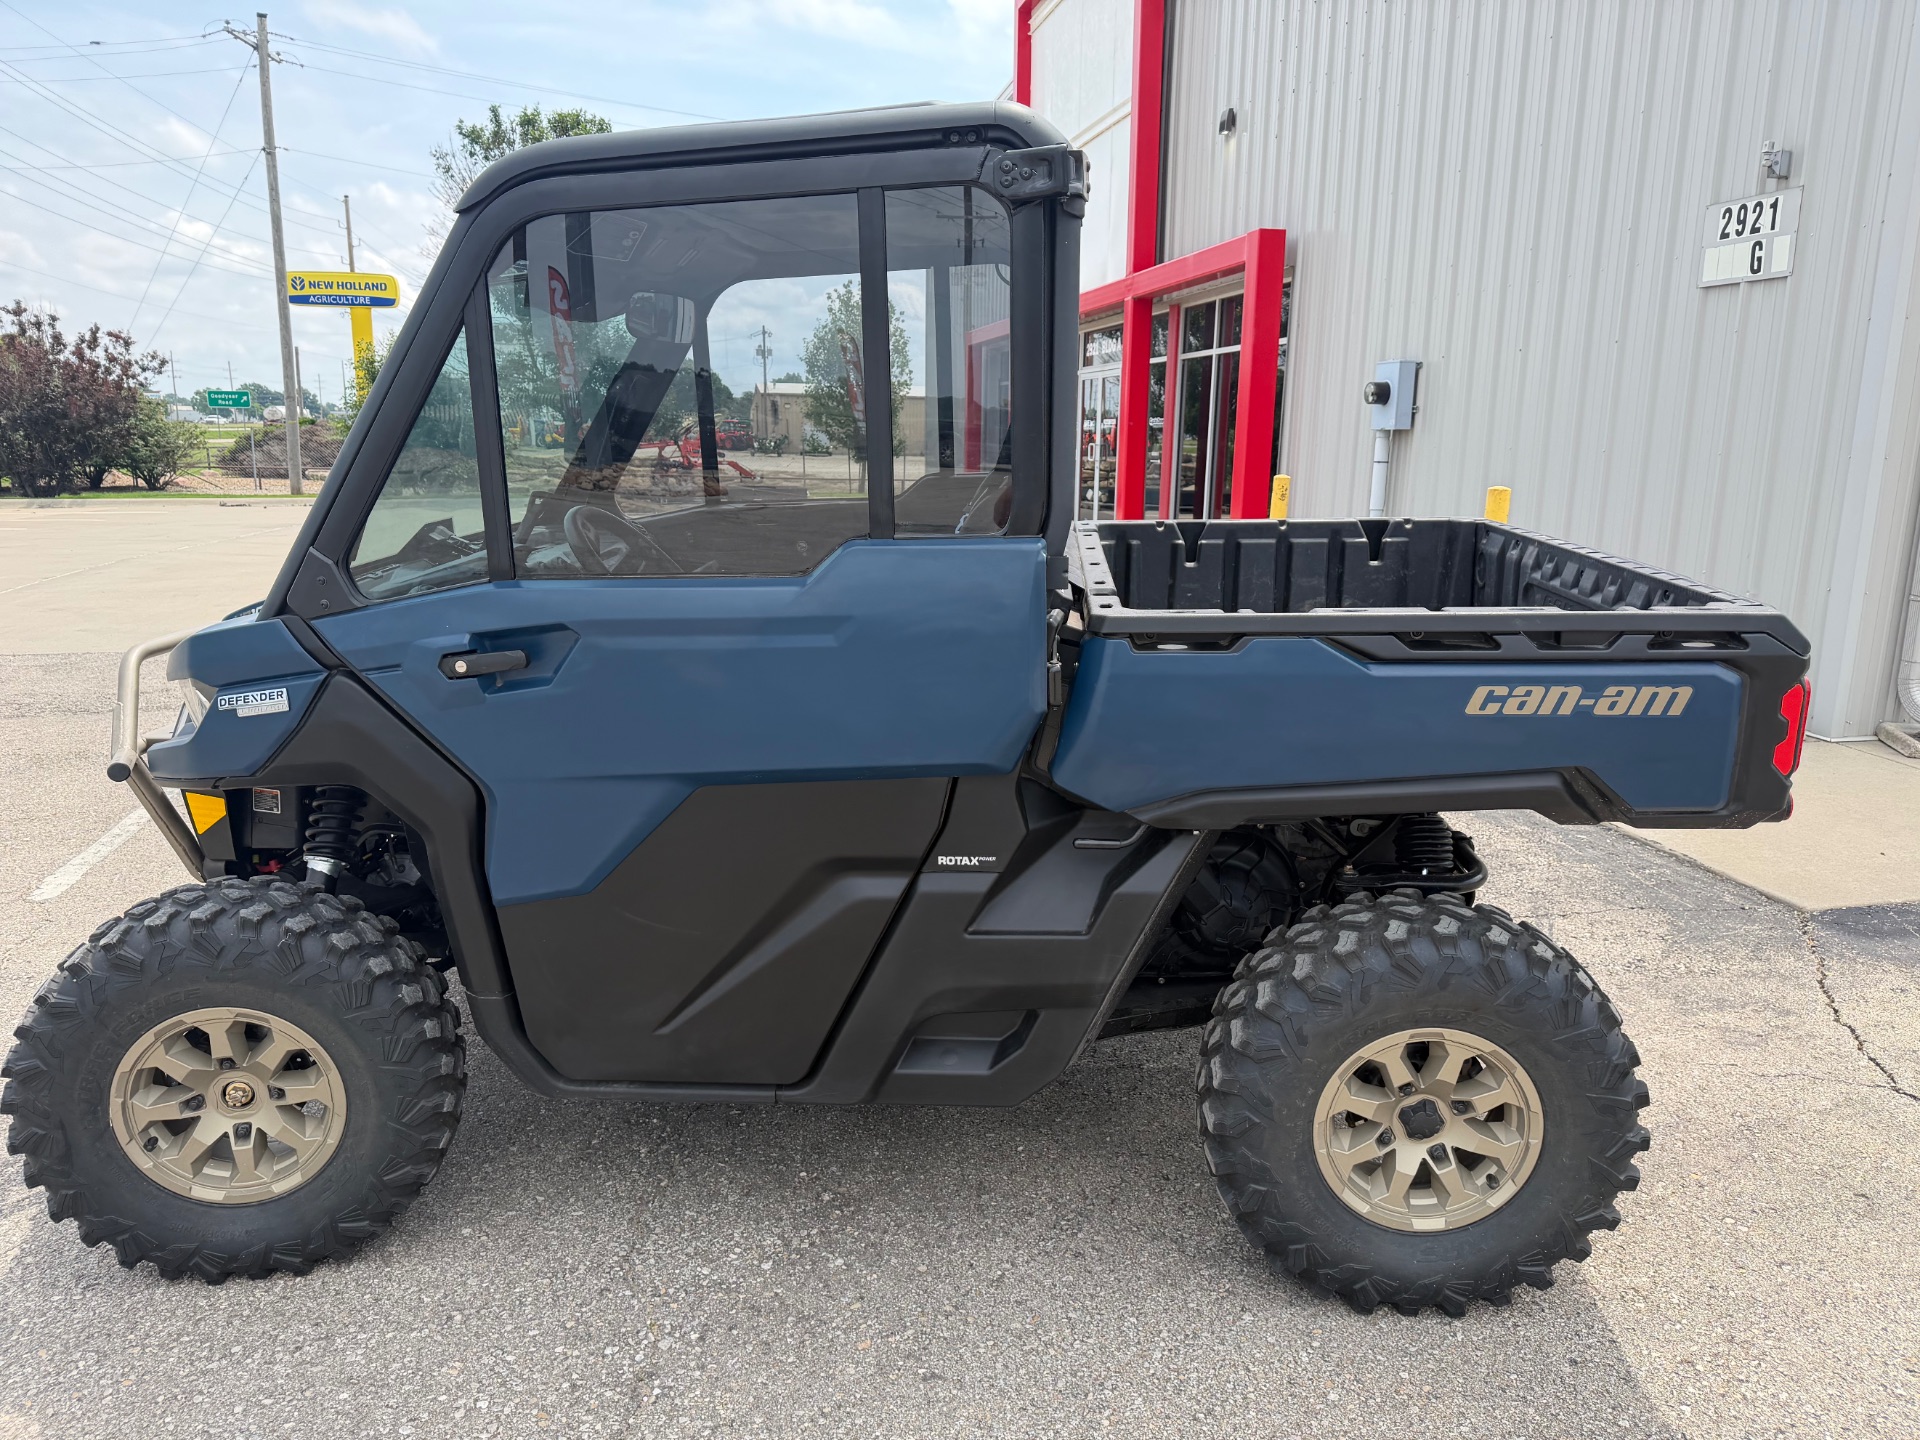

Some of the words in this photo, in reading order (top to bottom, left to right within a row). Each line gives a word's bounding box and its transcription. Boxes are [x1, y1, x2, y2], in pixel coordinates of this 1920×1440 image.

[1719, 197, 1779, 240] 2921
[1749, 240, 1764, 275] G
[308, 280, 334, 290] NEW
[336, 281, 387, 291] HOLLAND
[309, 295, 371, 304] AGRICULTURE
[219, 690, 284, 707] DEFENDER
[1464, 685, 1694, 715] can-am
[937, 856, 979, 865] ROTAX
